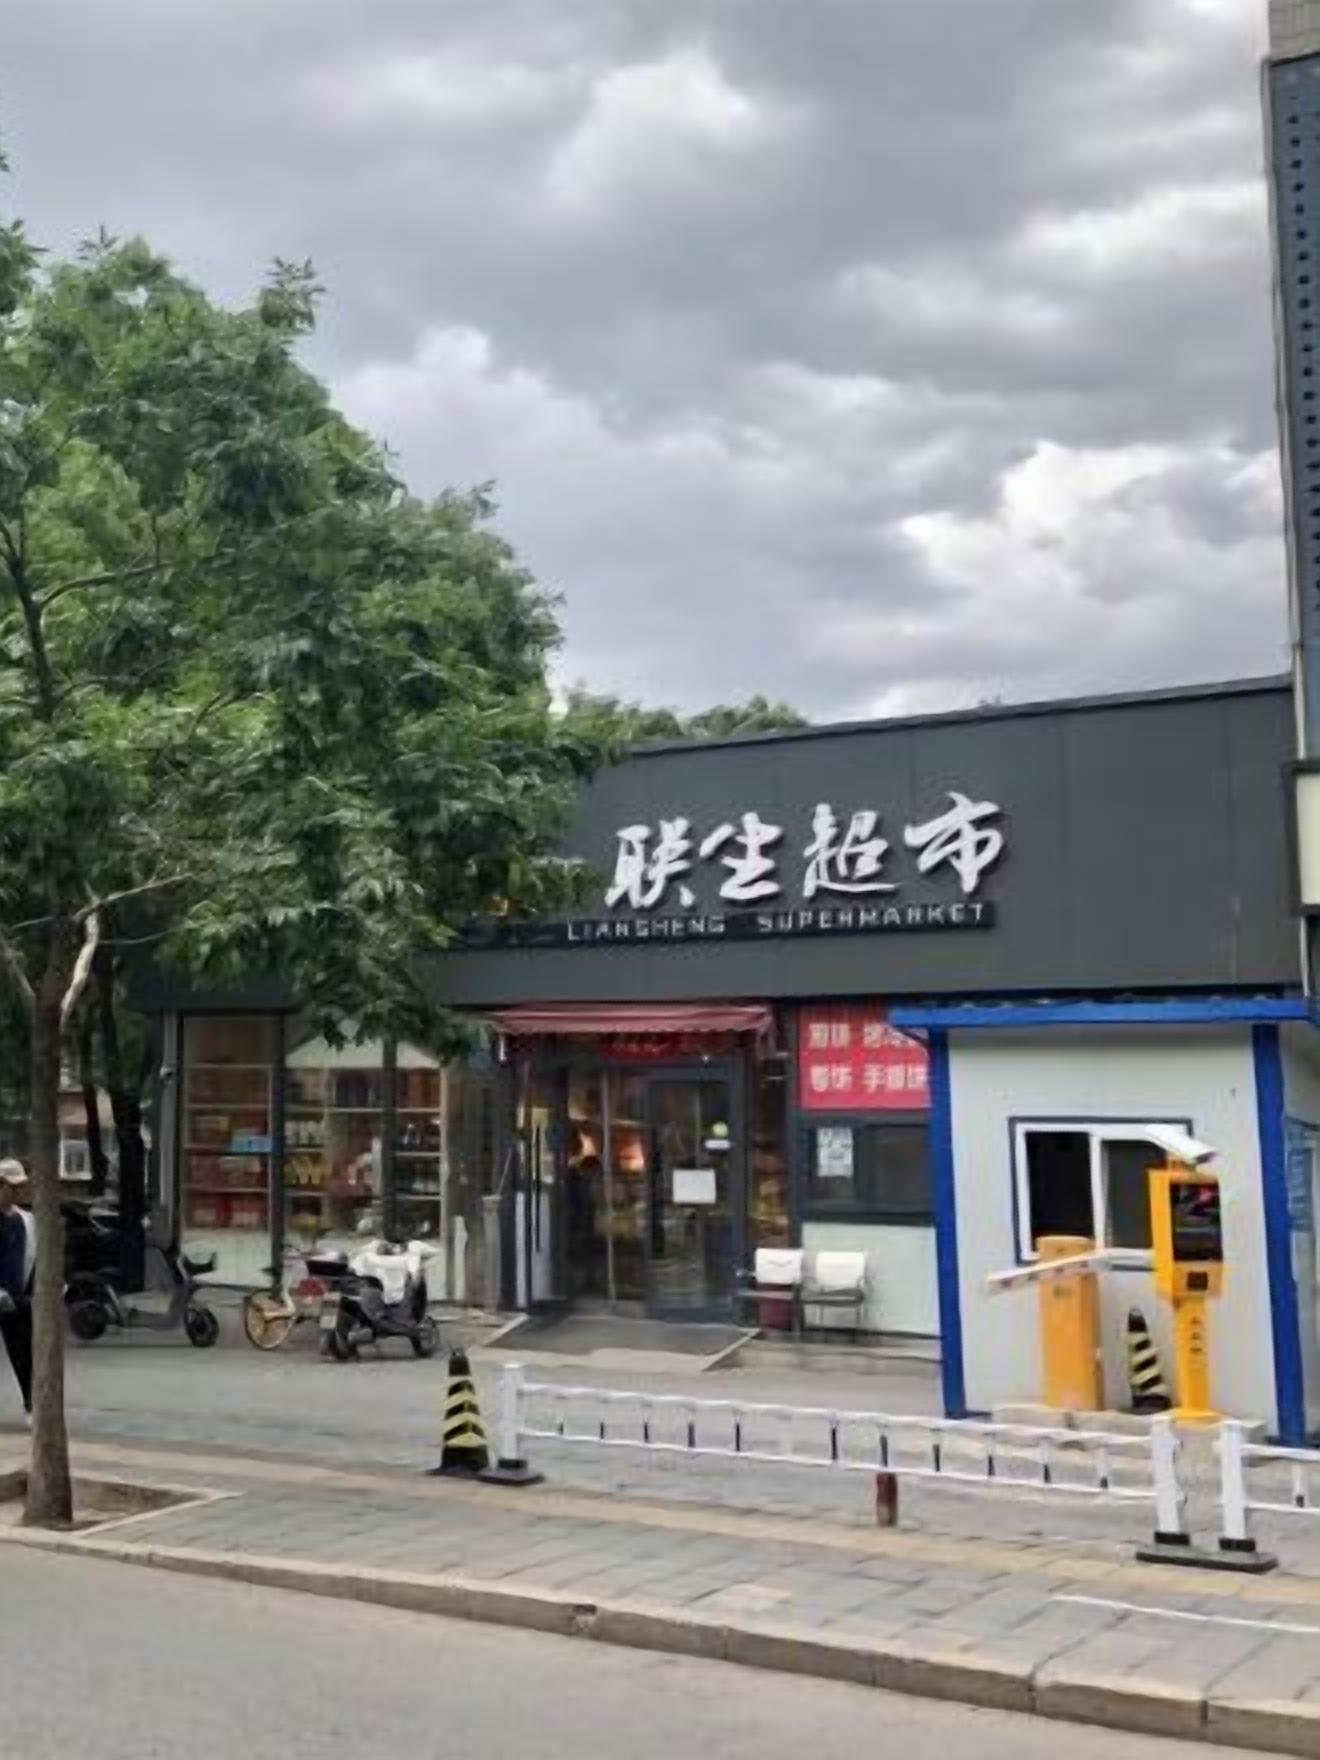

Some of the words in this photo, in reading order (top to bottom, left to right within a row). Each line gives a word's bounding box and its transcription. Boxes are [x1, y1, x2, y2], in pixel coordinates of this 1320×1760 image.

[604, 791, 1004, 909] 联生超市
[567, 914, 726, 941] LIANSHENG
[756, 903, 984, 932] SUPERMARKET
